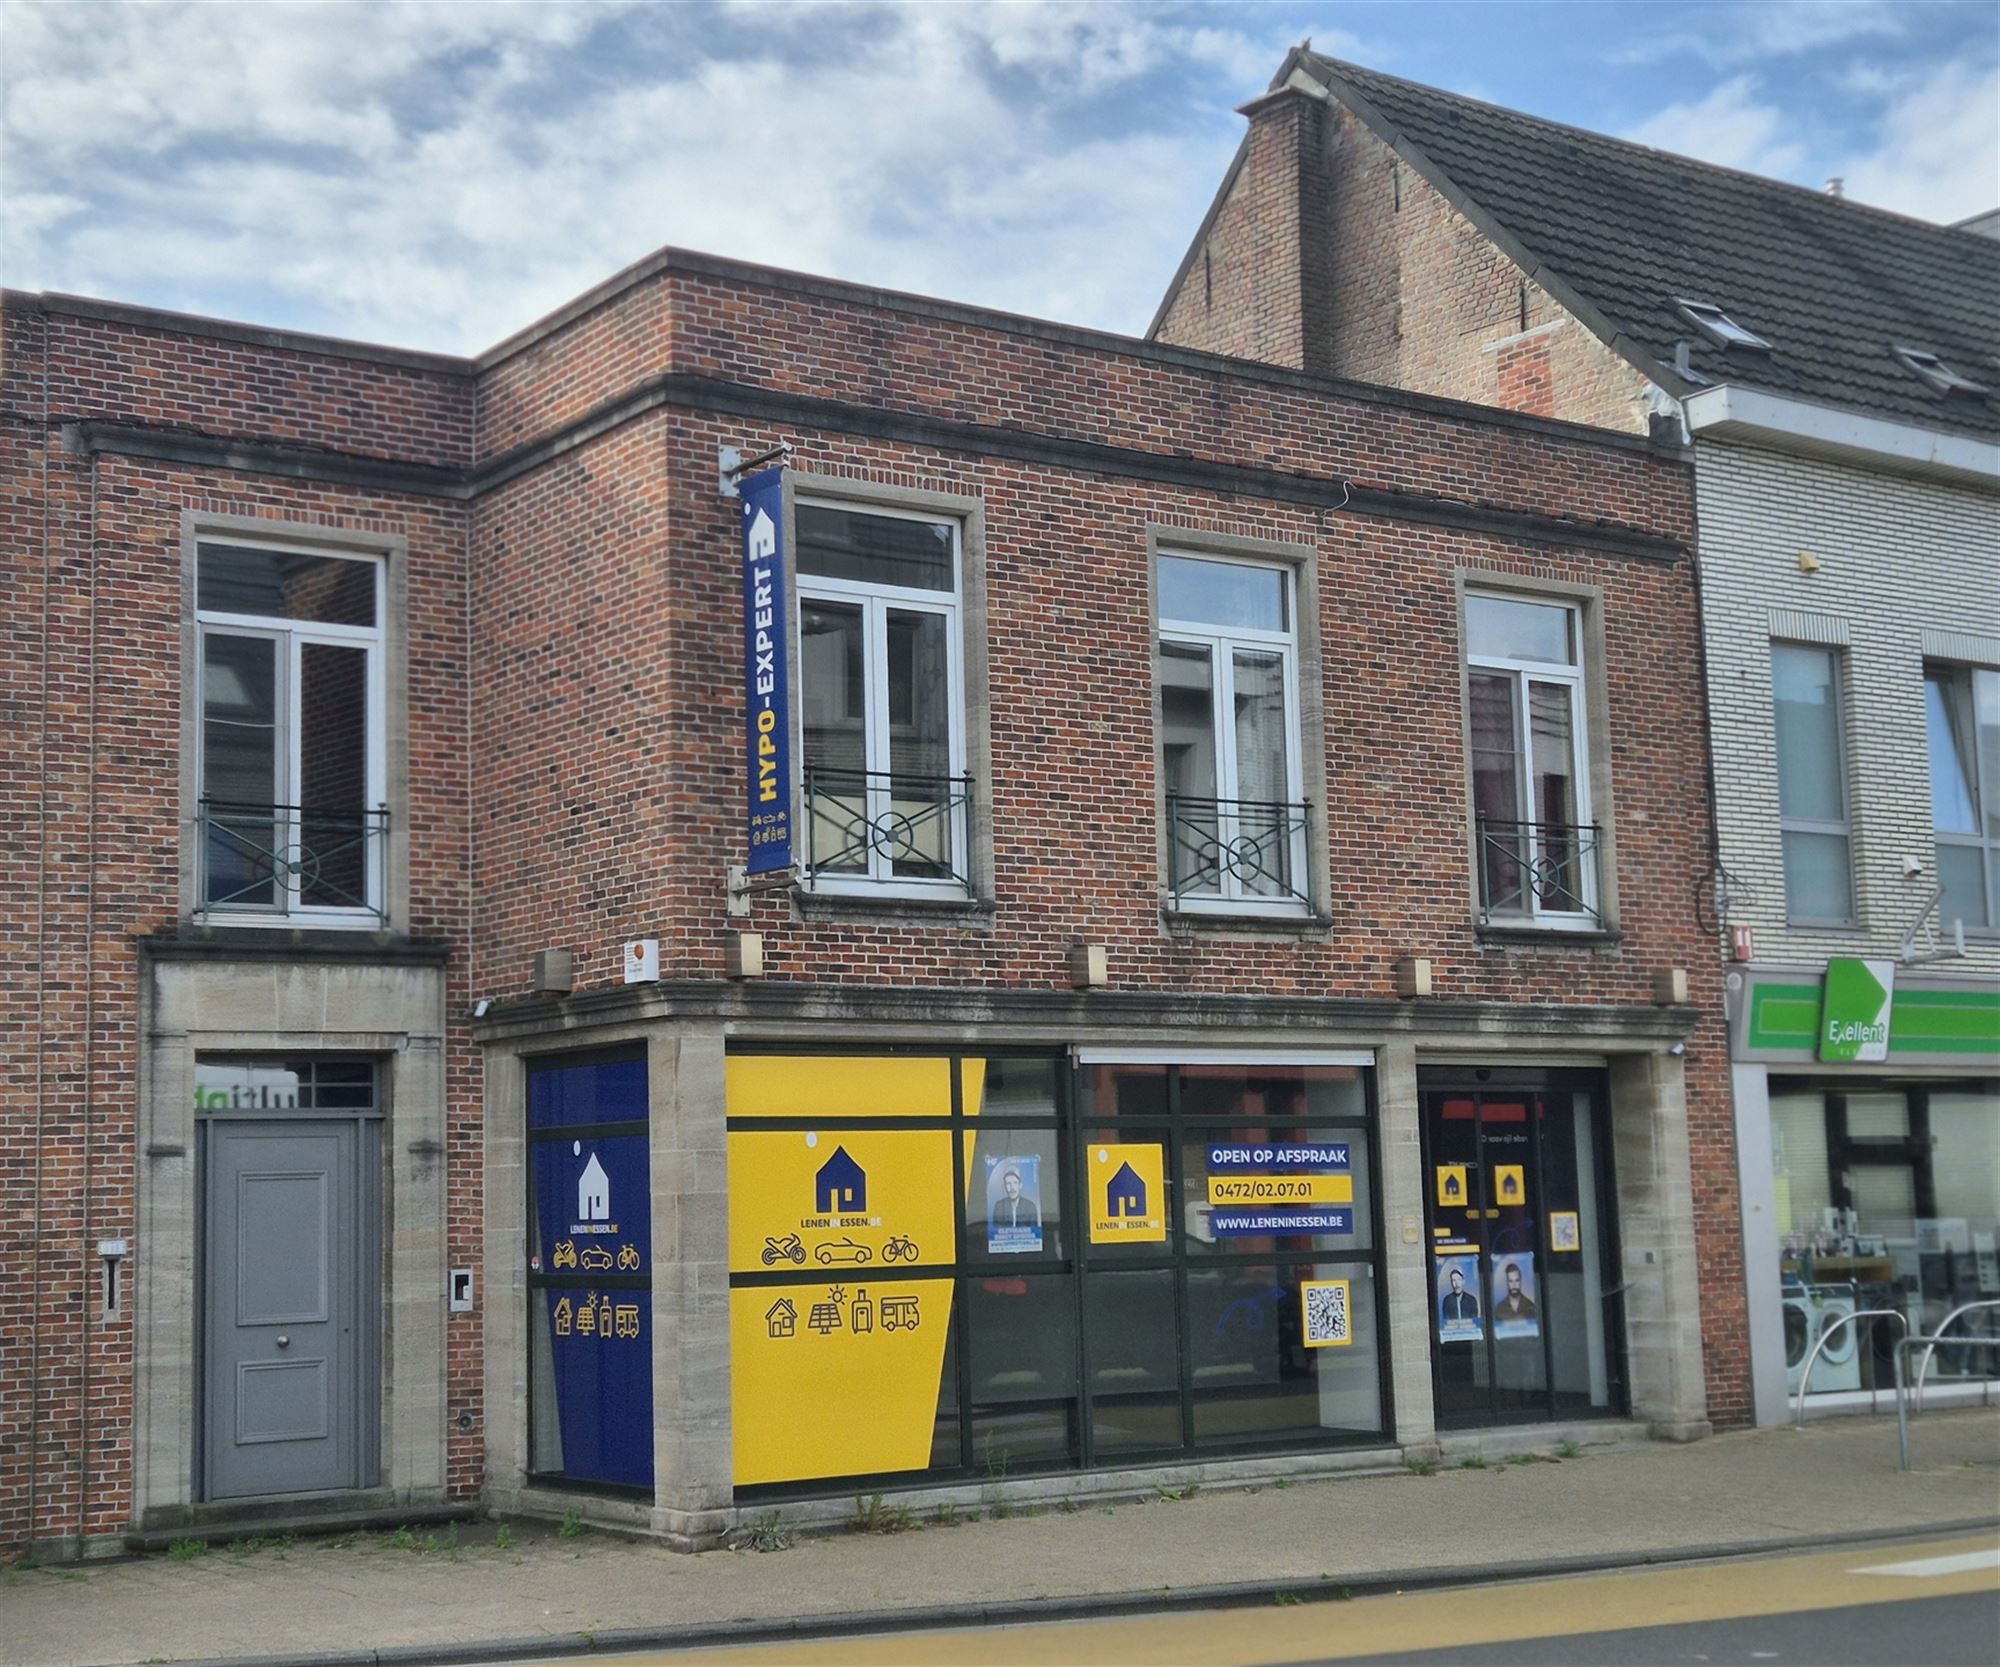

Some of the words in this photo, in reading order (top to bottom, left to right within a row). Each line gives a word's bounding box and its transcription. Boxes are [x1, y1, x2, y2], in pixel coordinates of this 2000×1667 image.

[754, 567, 777, 802] HYPO-EXPERT
[1829, 1020, 1885, 1045] Exellent
[1212, 1149, 1250, 1164] OPEN
[1254, 1149, 1273, 1164] OP
[1276, 1149, 1347, 1163] AFSPRAAK
[1215, 1181, 1312, 1198] 0472/02.07.01
[1216, 1215, 1343, 1230] WWW.LENENINESSEN.BE
